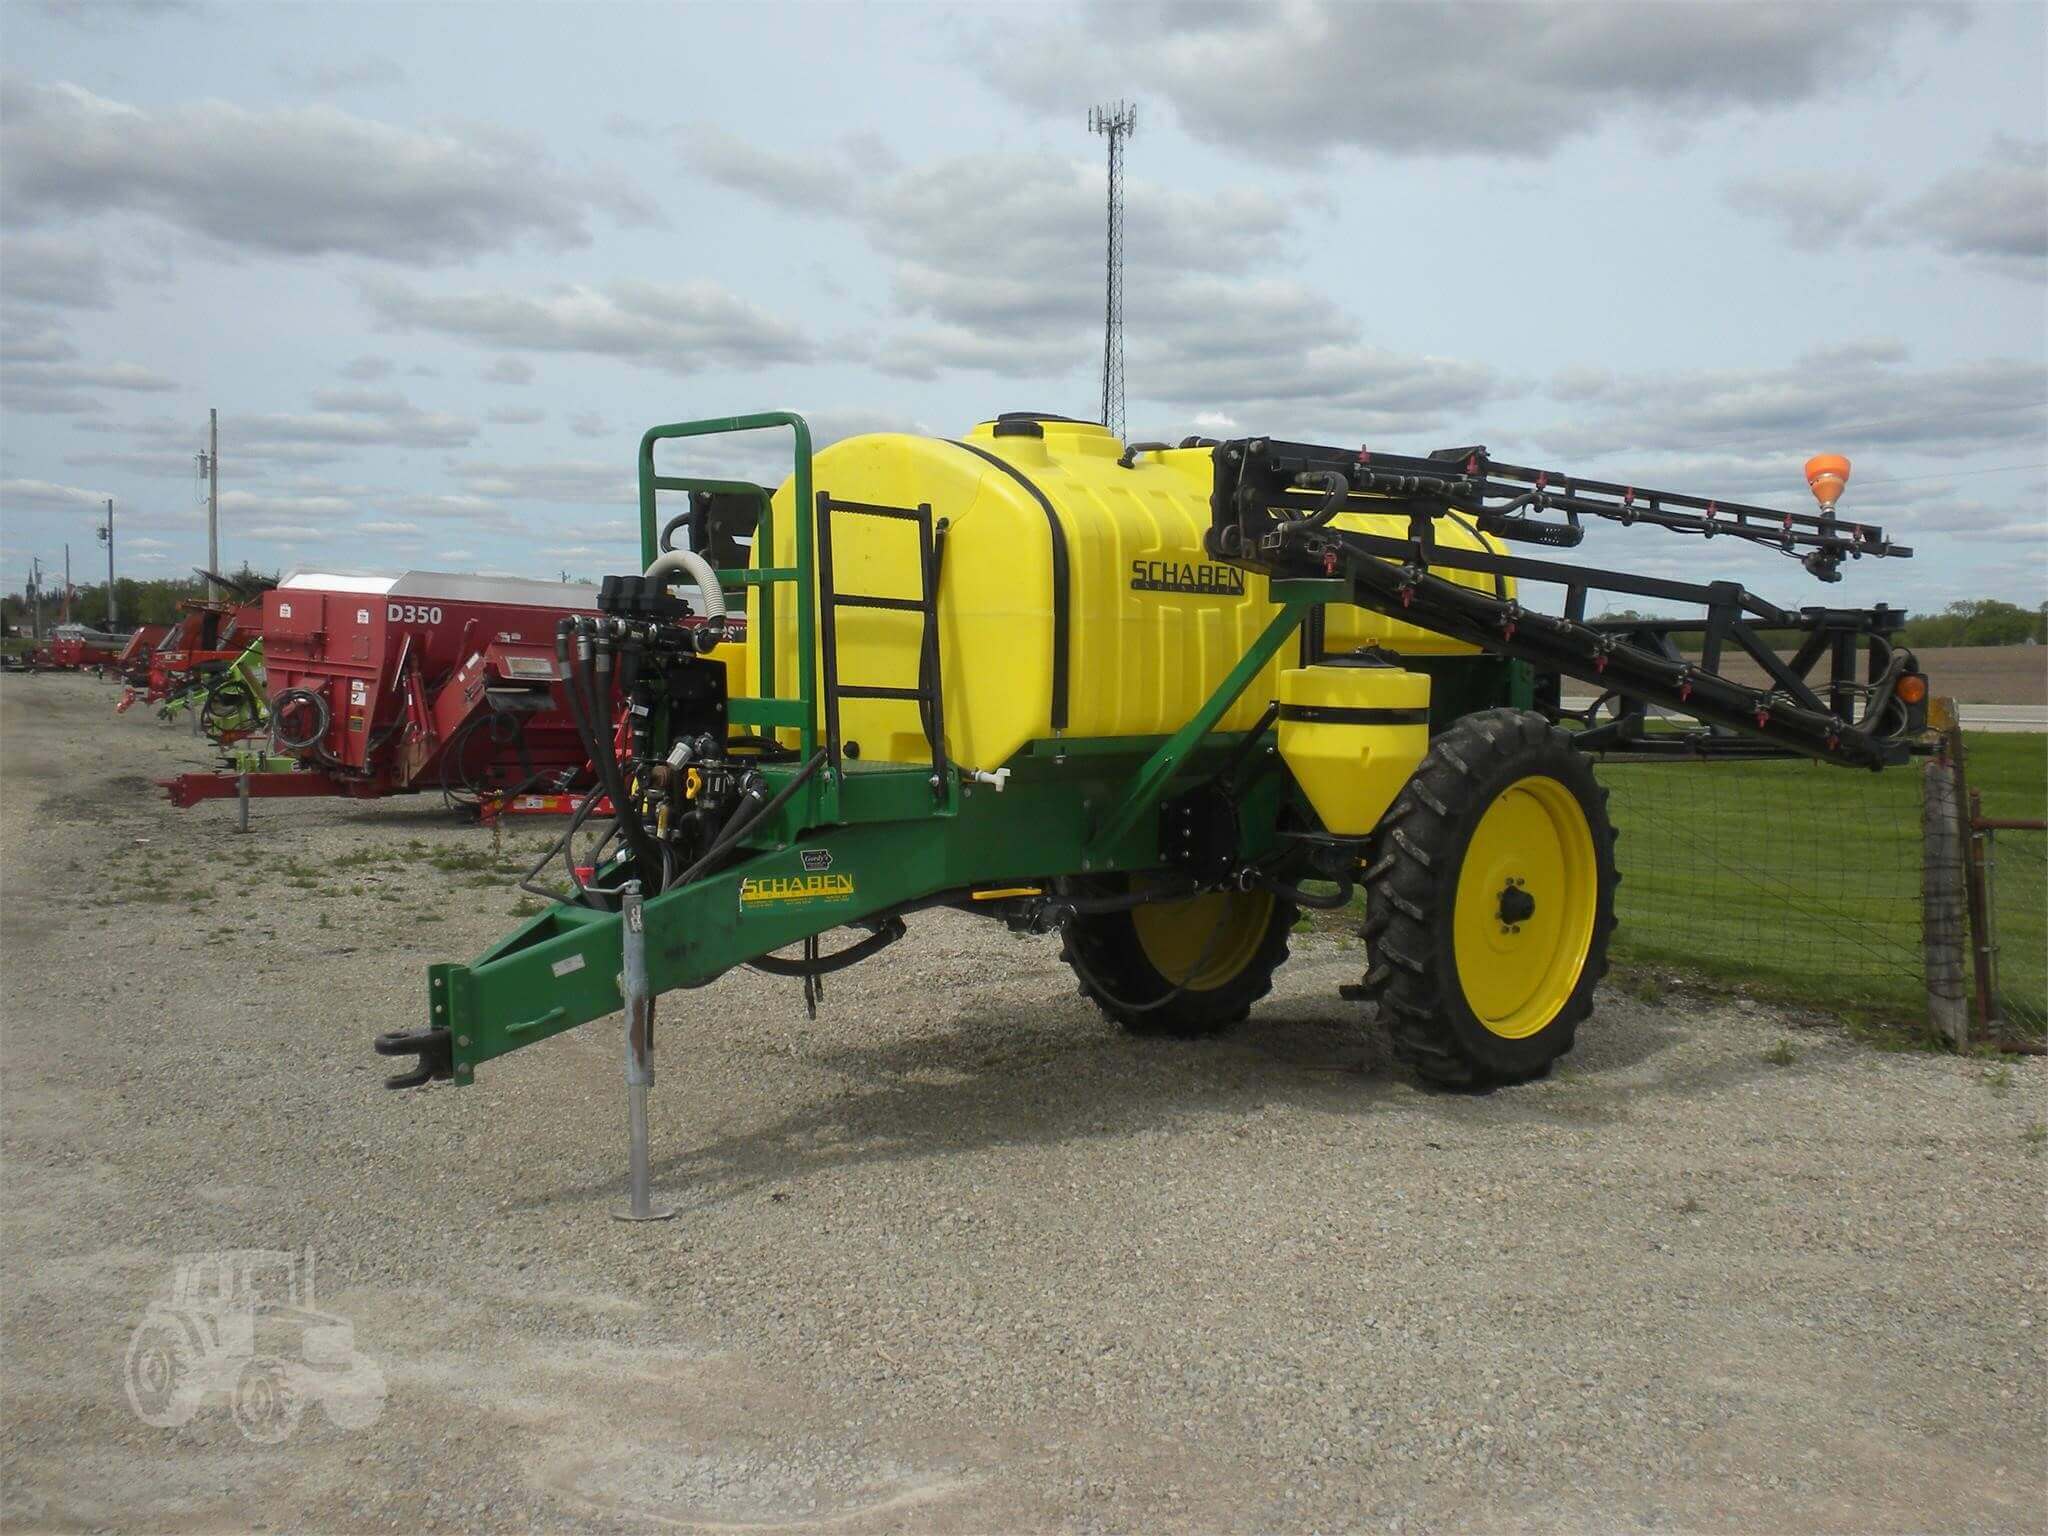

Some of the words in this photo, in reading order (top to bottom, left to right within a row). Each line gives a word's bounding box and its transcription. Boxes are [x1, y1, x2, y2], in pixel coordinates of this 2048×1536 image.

[1131, 560, 1245, 588] SCHABEN
[388, 604, 442, 625] D350
[742, 873, 853, 894] SCHABEN
